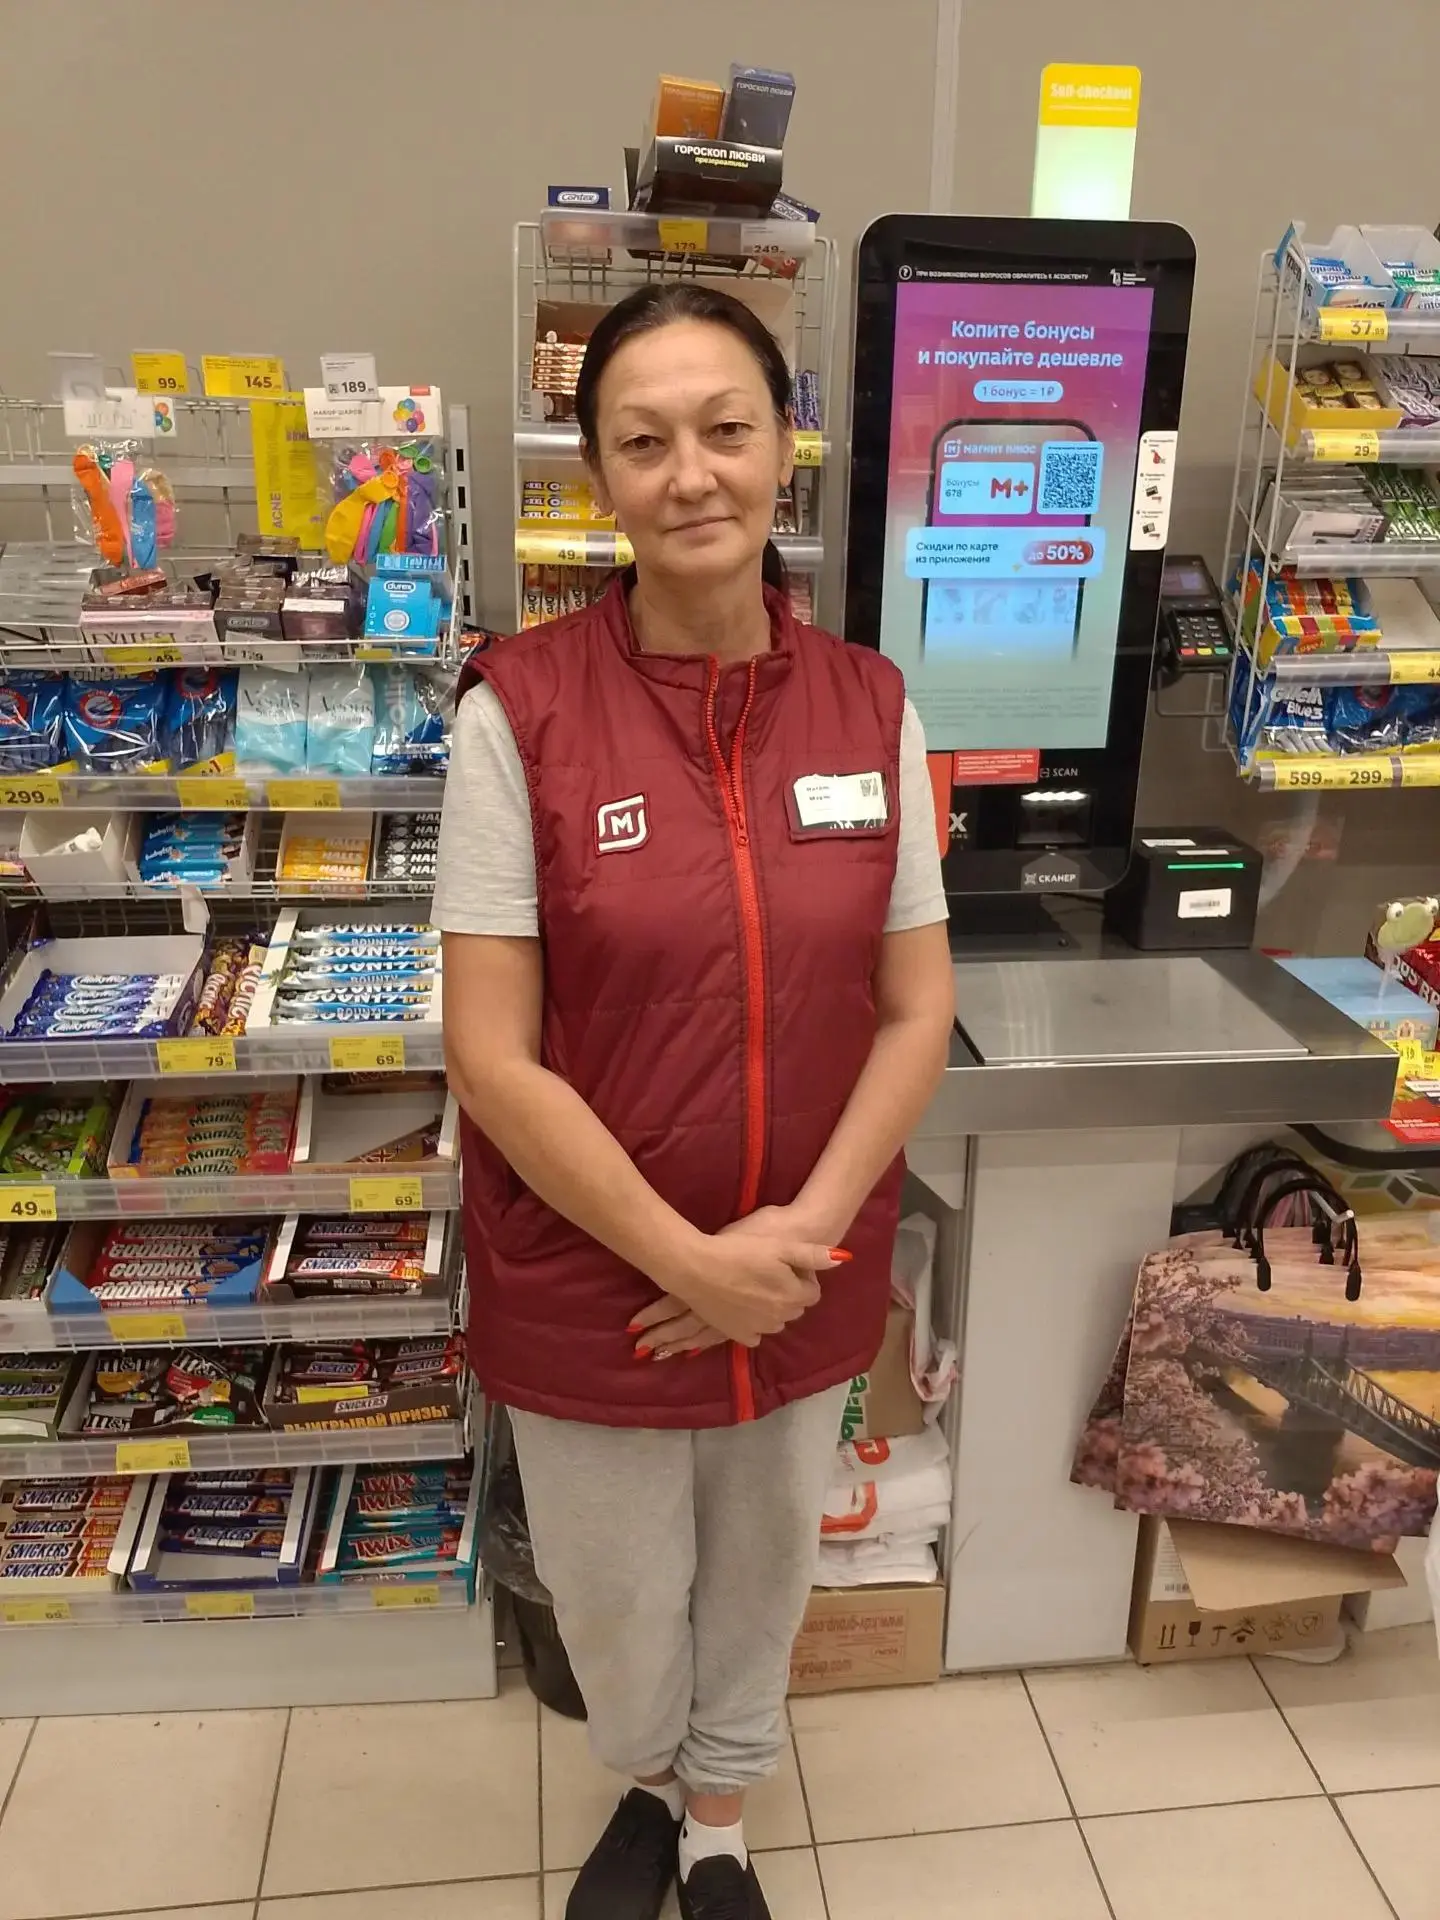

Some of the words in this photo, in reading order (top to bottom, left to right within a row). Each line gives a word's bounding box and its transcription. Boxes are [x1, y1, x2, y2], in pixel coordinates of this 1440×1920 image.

[674, 144, 727, 159] ГОРОСКОП
[729, 151, 766, 163] ЛЮБВИ
[952, 321, 1020, 338] Копите
[1024, 321, 1094, 343] бонусы
[918, 351, 930, 364] и
[935, 348, 1033, 369] покупайте
[1037, 352, 1123, 368] дешевле
[158, 377, 177, 389] 99
[245, 376, 273, 388] 145
[341, 381, 367, 393] 189
[990, 386, 1026, 399] бонус
[795, 449, 811, 461] 49
[1354, 446, 1370, 457] 29
[946, 479, 980, 489] Бонусы
[269, 491, 283, 528] ACNE
[916, 542, 953, 552] Скидки
[956, 543, 968, 551] по
[970, 543, 999, 552] карте
[1046, 545, 1085, 560] 50%
[557, 549, 576, 560] 49
[929, 556, 990, 565] приложения
[386, 582, 416, 591] durex
[1053, 768, 1078, 777] SCAN
[5, 791, 45, 803] 299
[319, 864, 362, 874] HALLS
[1038, 874, 1077, 883] СКАНЕР
[319, 946, 411, 957] BOUNTY
[304, 992, 400, 1003] BOUNTY
[205, 1057, 224, 1067] 79
[376, 1055, 395, 1065] 69
[189, 1112, 246, 1126] Mamba
[187, 1128, 246, 1144] Mamba
[188, 1146, 248, 1161] Mamba
[174, 1160, 239, 1176] Mamba
[395, 1195, 413, 1206] 69
[337, 1396, 387, 1411] SNICKERS
[18, 1489, 85, 1504] SNICKERS
[9, 1520, 77, 1534] SNICKERS
[6, 1542, 74, 1559] SNICKERS
[348, 1533, 414, 1560] TWIX
[1, 1562, 68, 1577] SNICKERS
